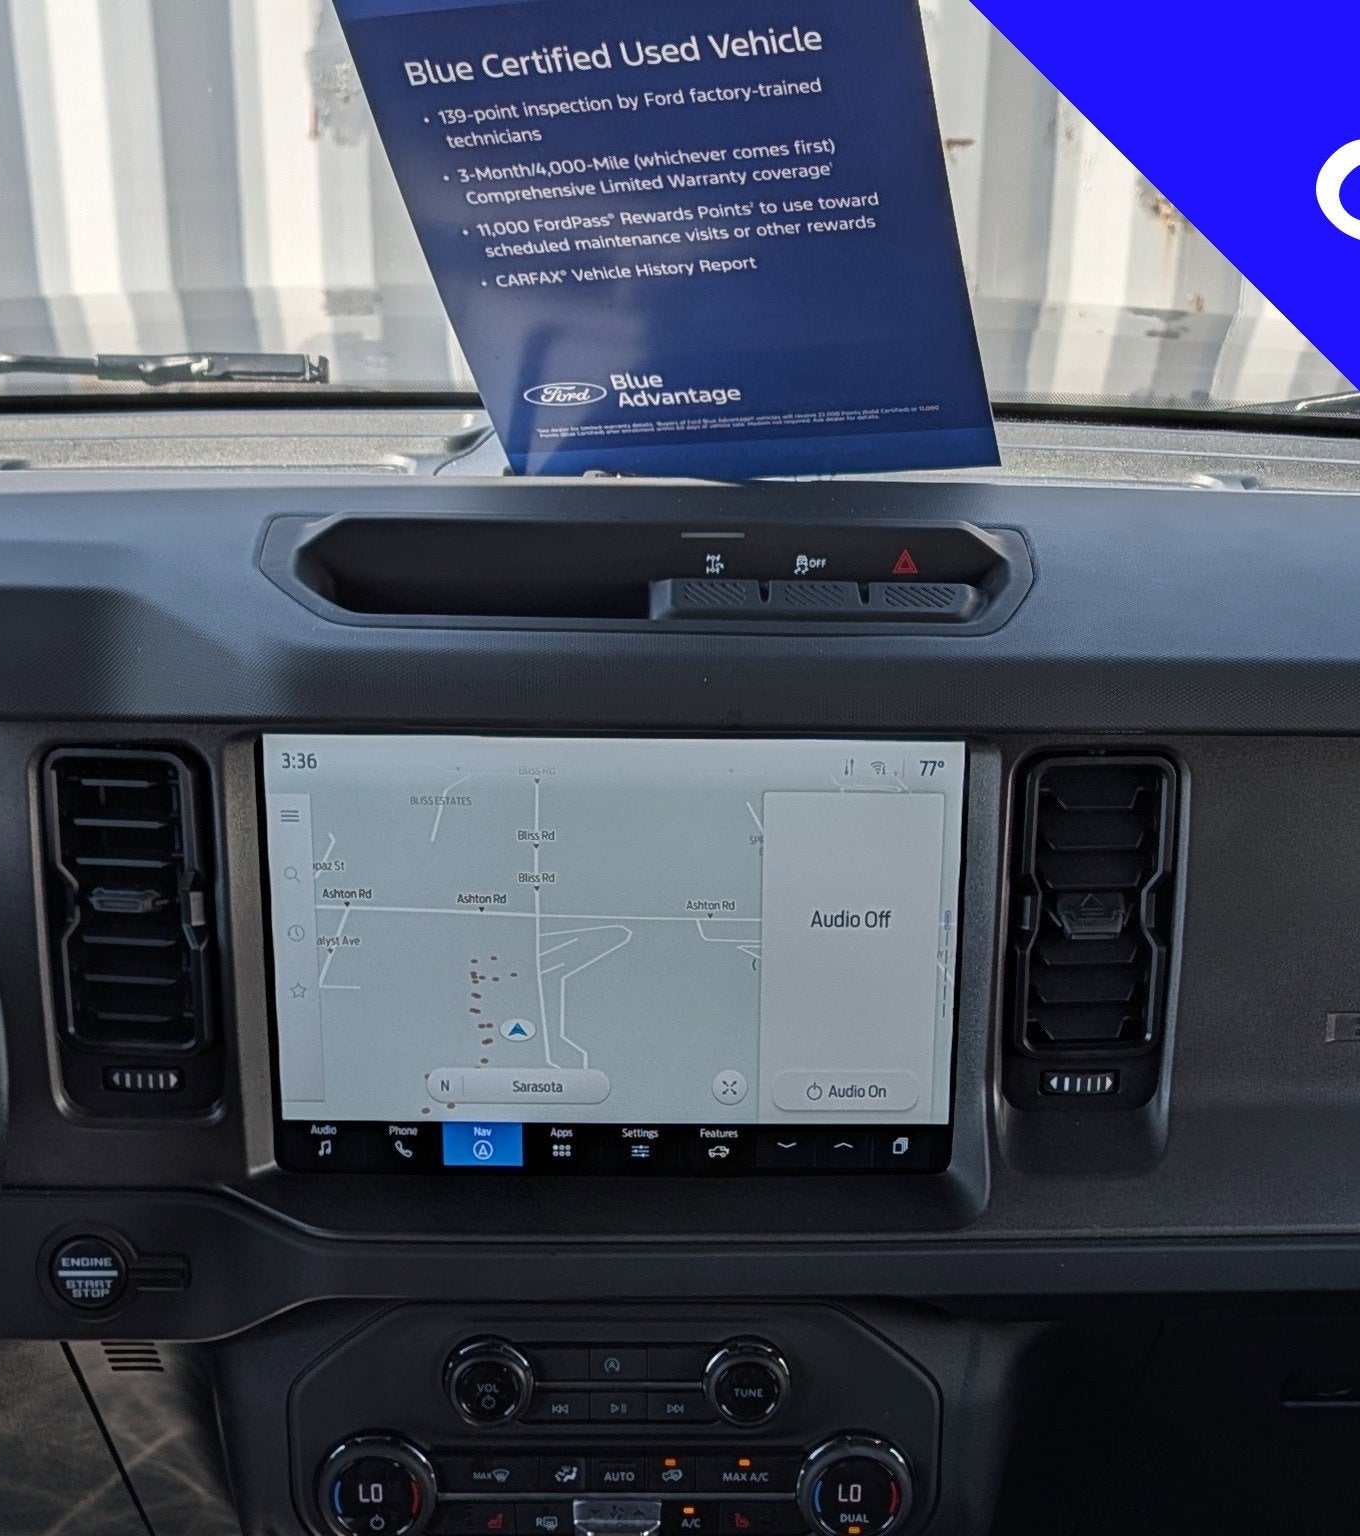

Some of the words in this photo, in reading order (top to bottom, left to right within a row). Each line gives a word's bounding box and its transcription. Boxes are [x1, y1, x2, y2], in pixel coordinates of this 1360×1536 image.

[404, 58, 474, 86] Blue
[481, 42, 612, 79] Certified
[619, 35, 701, 66] Used
[707, 26, 823, 59] Vehicle
[438, 102, 519, 125] 139-point
[524, 96, 613, 118] inspection
[616, 94, 638, 111] by
[644, 89, 685, 107] Ford
[689, 77, 822, 103] factory-trained
[446, 127, 542, 149] technicians
[457, 155, 629, 183] 3-Month/4,000-Mile
[634, 149, 727, 170] (whichever
[732, 144, 790, 160] comes
[794, 138, 836, 155] first)
[466, 182, 596, 205] Comprehensive
[600, 176, 664, 194] Limited
[667, 170, 747, 188] Warranty
[476, 220, 530, 238] 11,000
[620, 207, 693, 225] Rewards
[759, 201, 778, 215] to
[782, 198, 813, 212] use
[817, 192, 880, 210] toward
[485, 238, 571, 259] scheduled
[574, 231, 681, 251] maintenance
[685, 226, 730, 242] visits
[733, 226, 751, 239] or
[756, 220, 802, 237] other
[807, 214, 876, 233] rewards
[571, 263, 632, 282] Vehicle
[635, 259, 694, 278] History
[699, 257, 758, 275] Report
[609, 372, 663, 390] Blue
[618, 387, 742, 408] Advantage
[810, 559, 826, 568] OFF
[281, 752, 318, 770] 3:36
[919, 760, 945, 777] 77°
[518, 765, 541, 775] Bliss
[542, 765, 556, 775] Rd
[410, 796, 433, 806] BLISS
[434, 796, 472, 806] ESTATES
[517, 830, 540, 841] Bliss
[541, 830, 555, 841] Rd
[333, 860, 346, 871] St
[518, 872, 540, 883] Bliss
[541, 872, 555, 883] Rd
[322, 888, 357, 900] Ashton
[358, 889, 372, 900] Rd
[456, 893, 492, 905] Ashton
[493, 893, 507, 905] Rd
[686, 900, 720, 911] Ashton
[722, 900, 736, 911] Rd
[810, 910, 861, 928] Audio
[864, 910, 892, 928] Off
[341, 936, 360, 946] Ave
[441, 1080, 450, 1091] N
[512, 1080, 564, 1094] Sarasota
[828, 1085, 866, 1098] Audio
[868, 1085, 887, 1098] On
[310, 1124, 338, 1135] Audio
[389, 1125, 419, 1137] Phone
[474, 1126, 492, 1137] Nav
[550, 1127, 574, 1139] Apps
[622, 1128, 659, 1140] Settings
[699, 1128, 739, 1139] Features
[61, 1257, 112, 1267] ENGINE
[65, 1279, 113, 1289] START
[72, 1289, 110, 1298] STOP
[476, 1383, 500, 1394] VOL
[733, 1388, 764, 1399] TUNE
[472, 1471, 492, 1481] MAX
[604, 1472, 635, 1482] AUTO
[722, 1472, 748, 1482] MAX
[750, 1472, 769, 1483] A/C
[358, 1483, 383, 1503] LO
[838, 1483, 862, 1503] LO
[681, 1519, 701, 1529] A/C
[840, 1513, 869, 1524] DUAL
